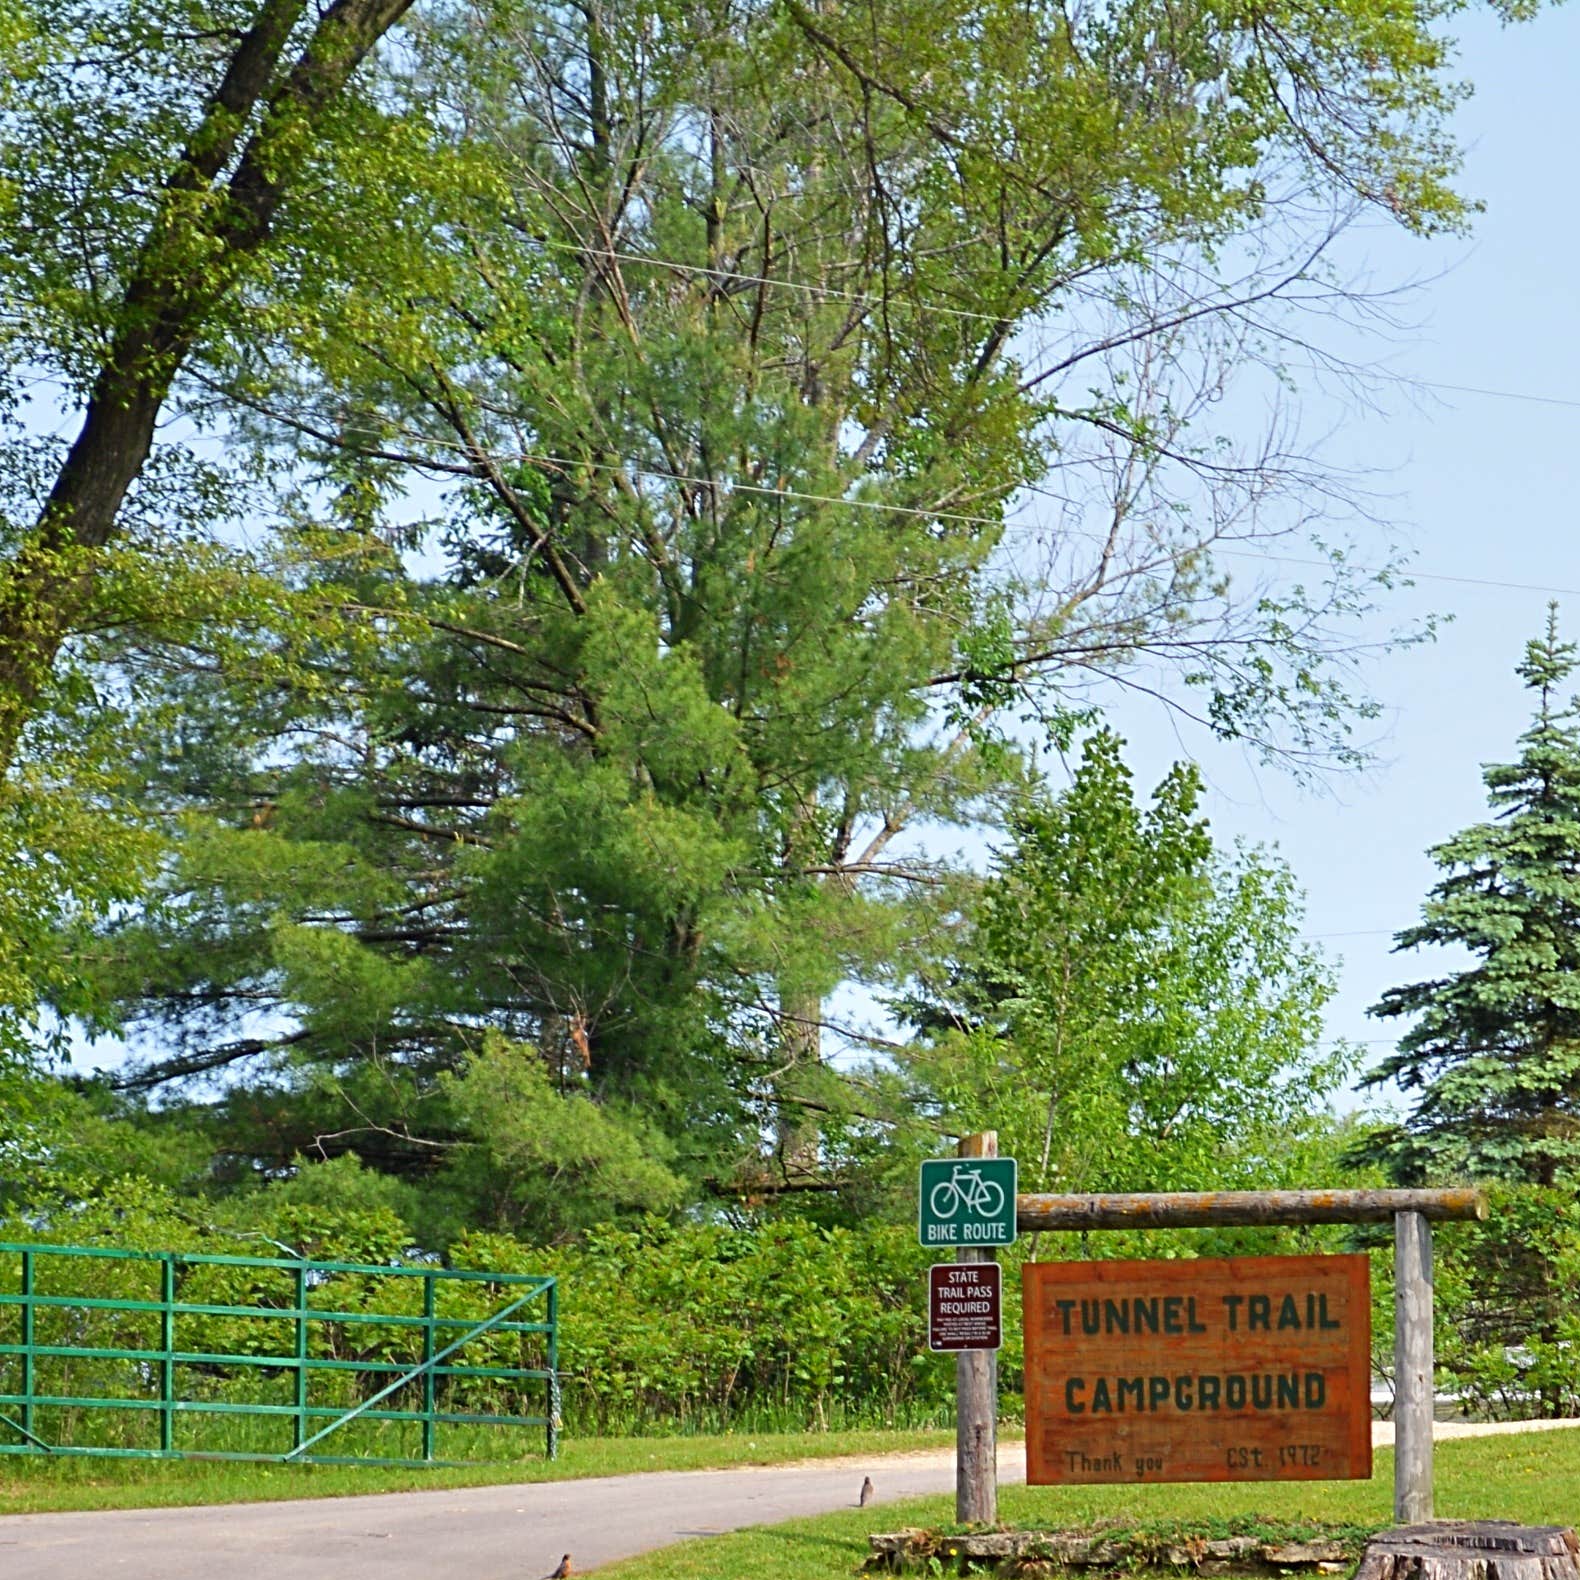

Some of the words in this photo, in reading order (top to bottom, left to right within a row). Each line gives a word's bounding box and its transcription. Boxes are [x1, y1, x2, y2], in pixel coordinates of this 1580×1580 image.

[928, 1224, 957, 1240] BIKE
[963, 1223, 1006, 1239] ROUTE
[948, 1271, 979, 1283] STATE
[938, 1287, 965, 1298] TRAIL
[967, 1286, 992, 1297] PASS
[940, 1301, 990, 1314] REQUIRED
[1057, 1297, 1206, 1335] TUNNEL
[1223, 1293, 1341, 1332] TRAIL
[1065, 1373, 1327, 1413] CAMPGROUND
[1065, 1450, 1123, 1473] Thank
[1135, 1456, 1164, 1477] you
[1279, 1444, 1322, 1467] 1972
